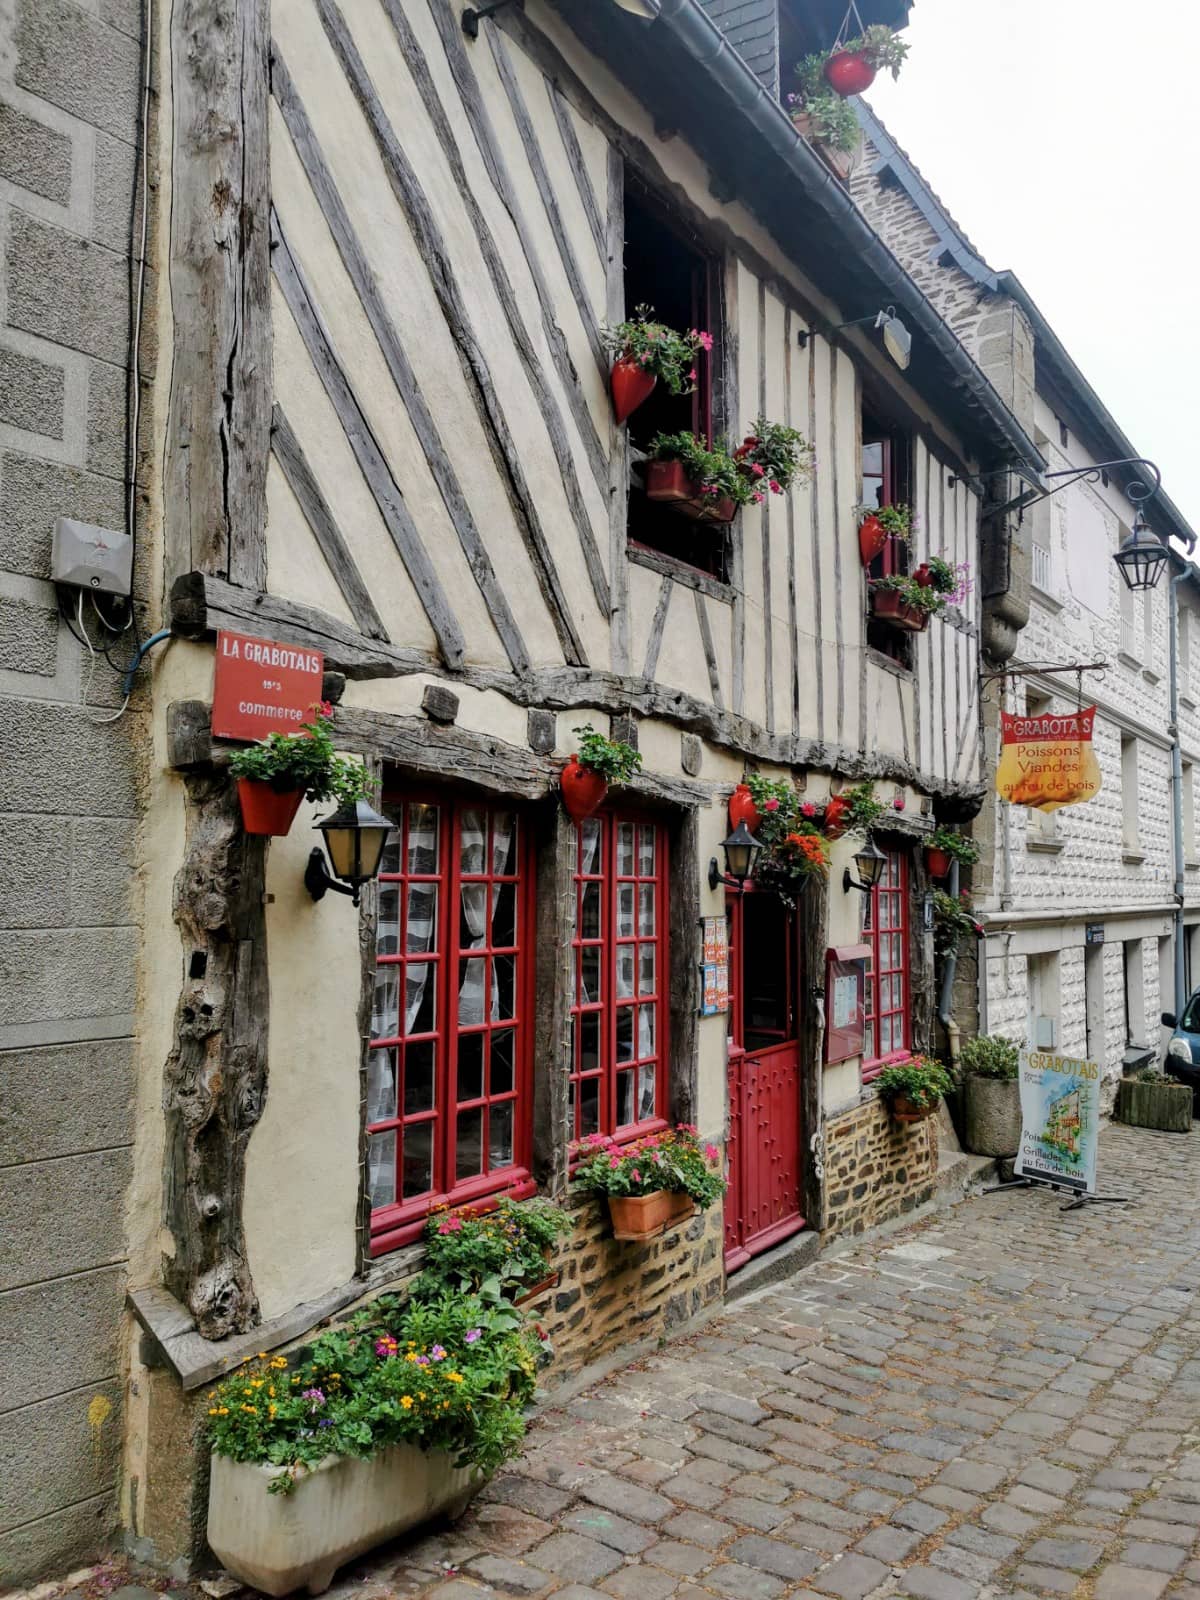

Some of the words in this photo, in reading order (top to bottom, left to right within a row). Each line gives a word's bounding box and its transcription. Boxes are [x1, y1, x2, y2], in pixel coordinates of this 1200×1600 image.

[223, 638, 239, 658] LA
[244, 642, 319, 673] GRABOTAIS
[239, 701, 303, 721] commerce
[1013, 718, 1091, 736] GRABOTAS
[1017, 745, 1079, 758] Poissons
[1018, 759, 1079, 773] Viandes
[1046, 779, 1064, 790] de
[1067, 779, 1095, 790] bois
[1029, 1052, 1098, 1079] GRABOTAIS
[1023, 1145, 1062, 1163] Grillades
[1022, 1158, 1033, 1166] au
[1035, 1158, 1050, 1170] feu
[1051, 1163, 1064, 1174] de
[1065, 1166, 1084, 1179] bois
